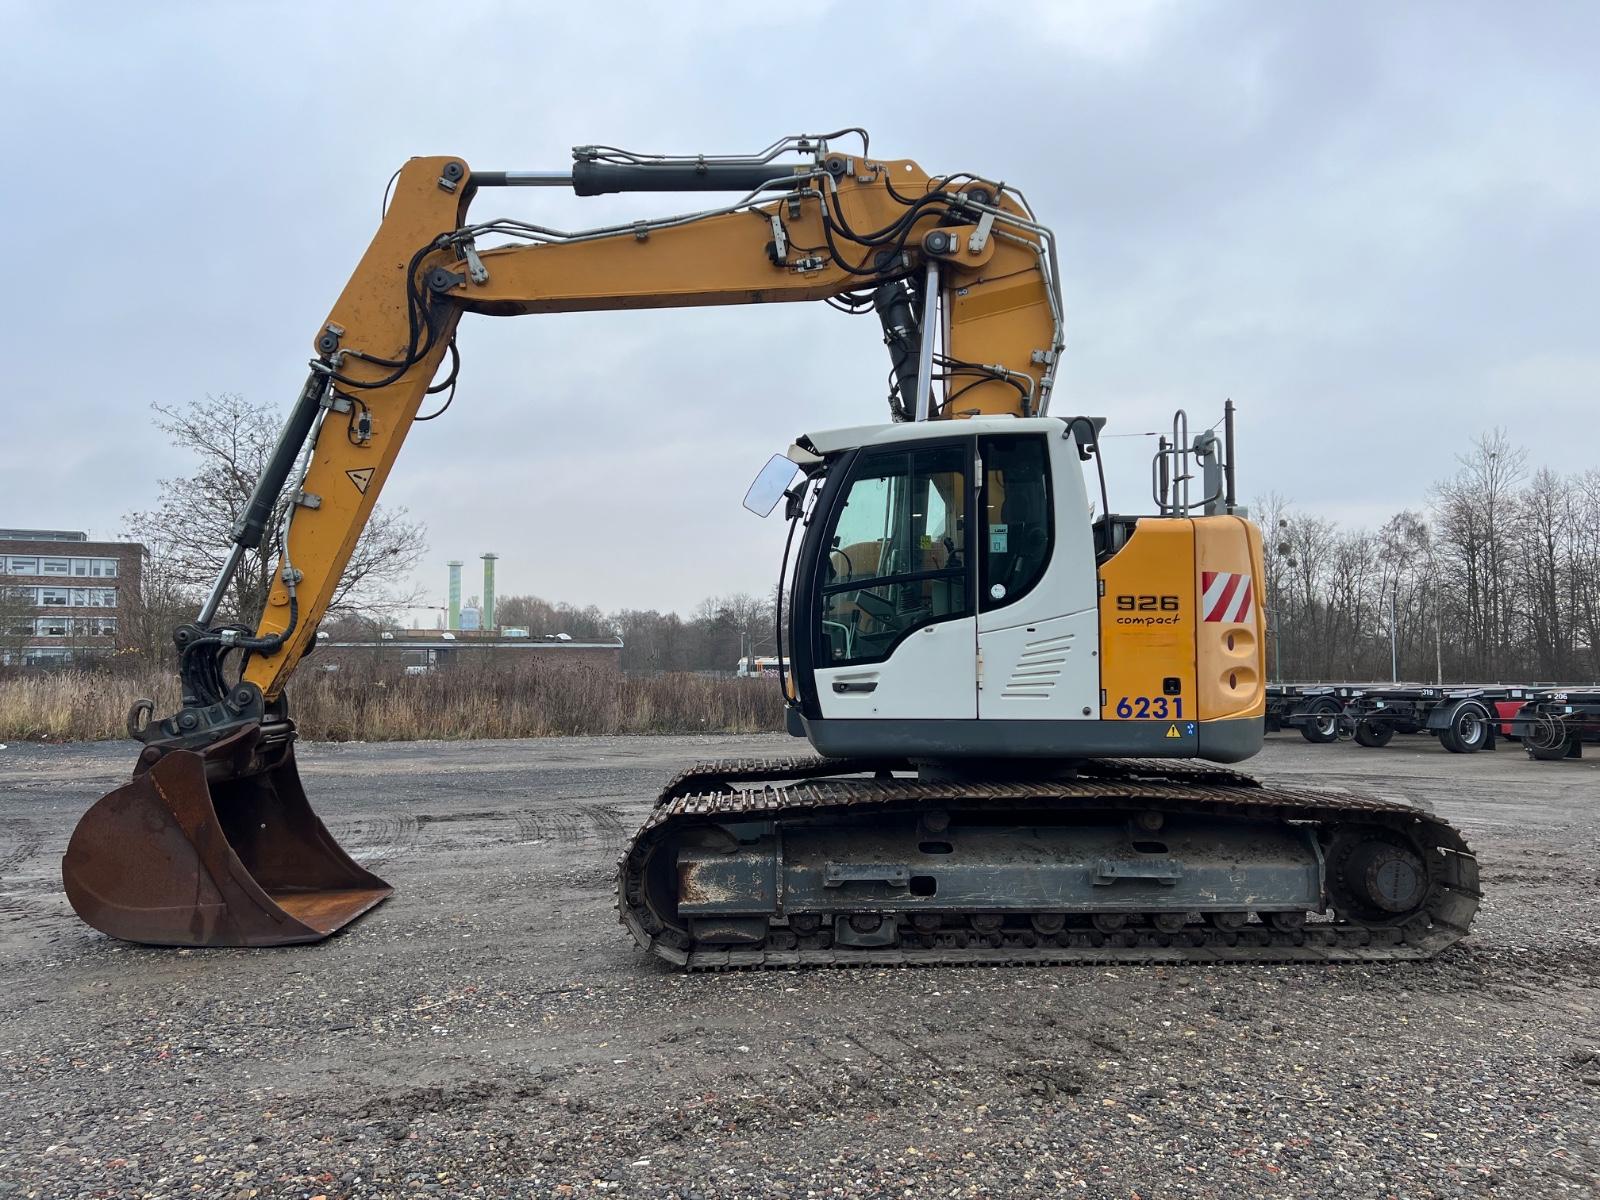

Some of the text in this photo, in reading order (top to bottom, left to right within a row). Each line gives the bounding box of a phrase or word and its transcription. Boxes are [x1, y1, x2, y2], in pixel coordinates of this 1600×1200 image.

[1117, 596, 1179, 611] 926
[1116, 613, 1180, 627] compact
[1116, 697, 1183, 719] 6231
